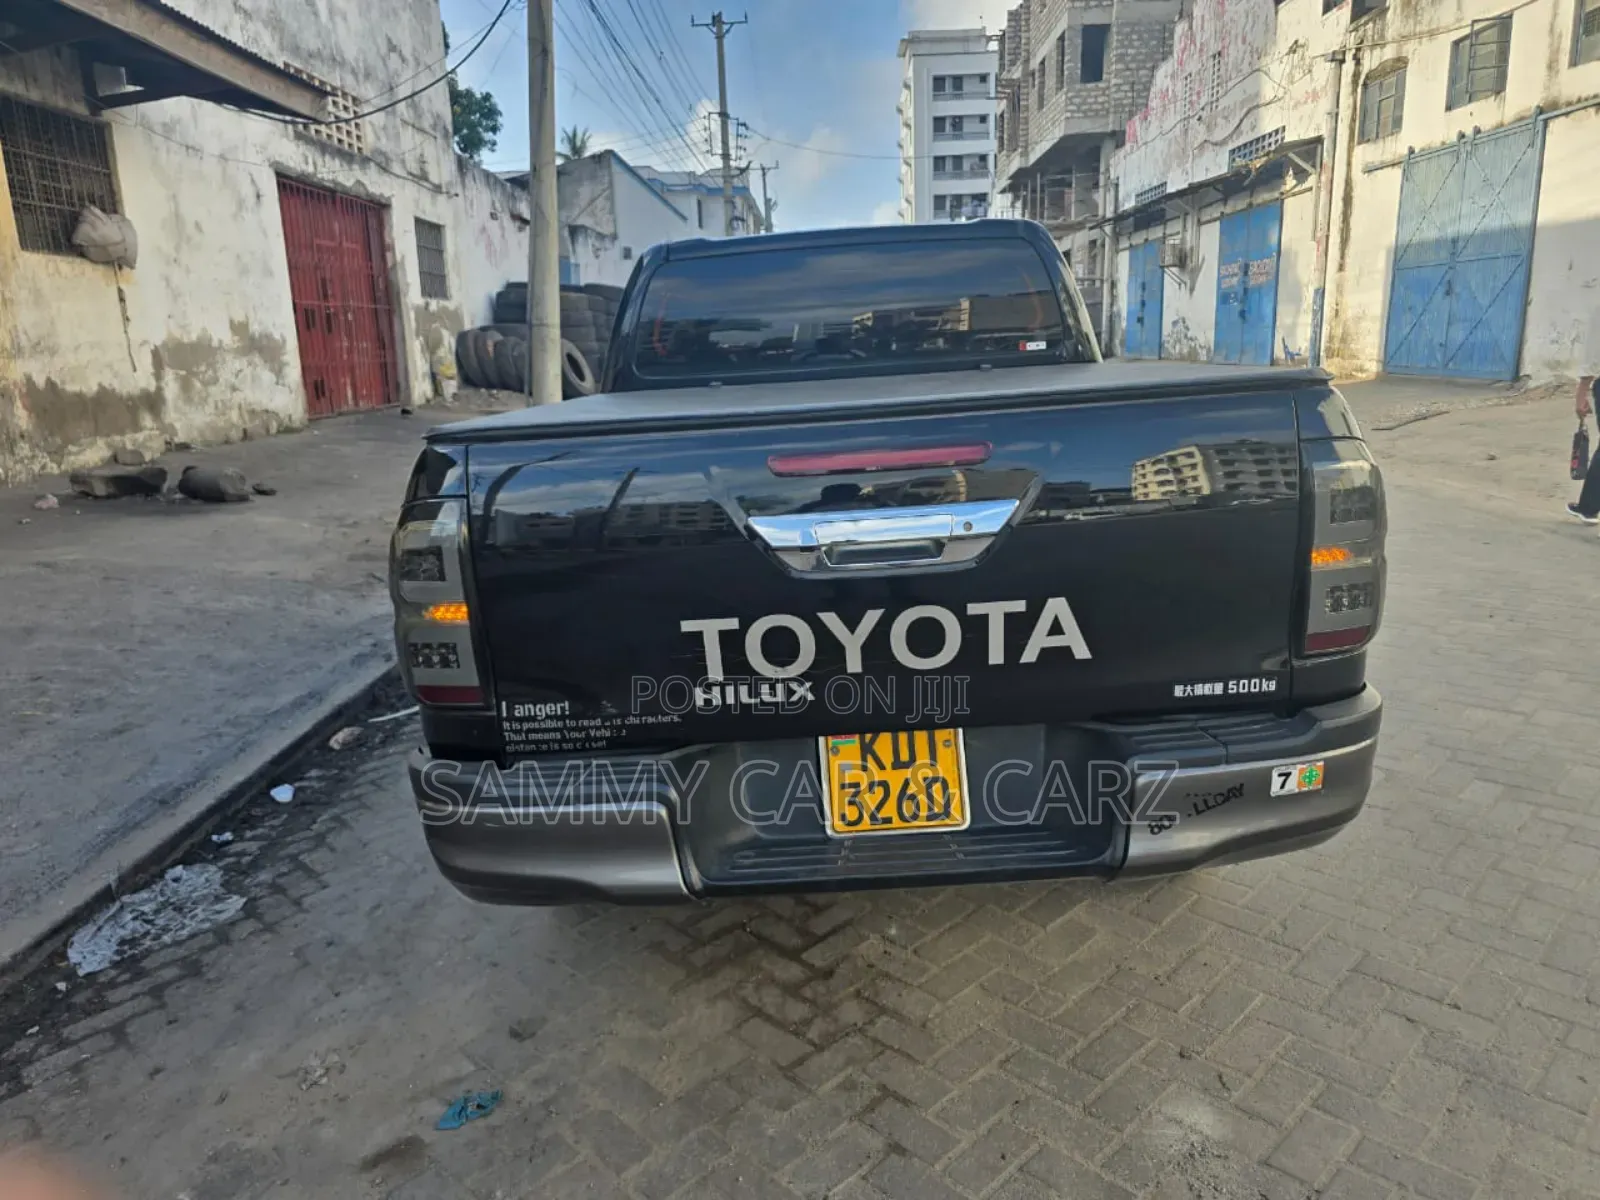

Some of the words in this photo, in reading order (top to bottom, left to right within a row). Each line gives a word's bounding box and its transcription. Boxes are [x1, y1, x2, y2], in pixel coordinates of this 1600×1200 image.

[680, 597, 1092, 682] TOYOTA
[694, 681, 816, 706] HILUX
[1228, 678, 1276, 694] 500kg
[1277, 770, 1293, 790] 7
